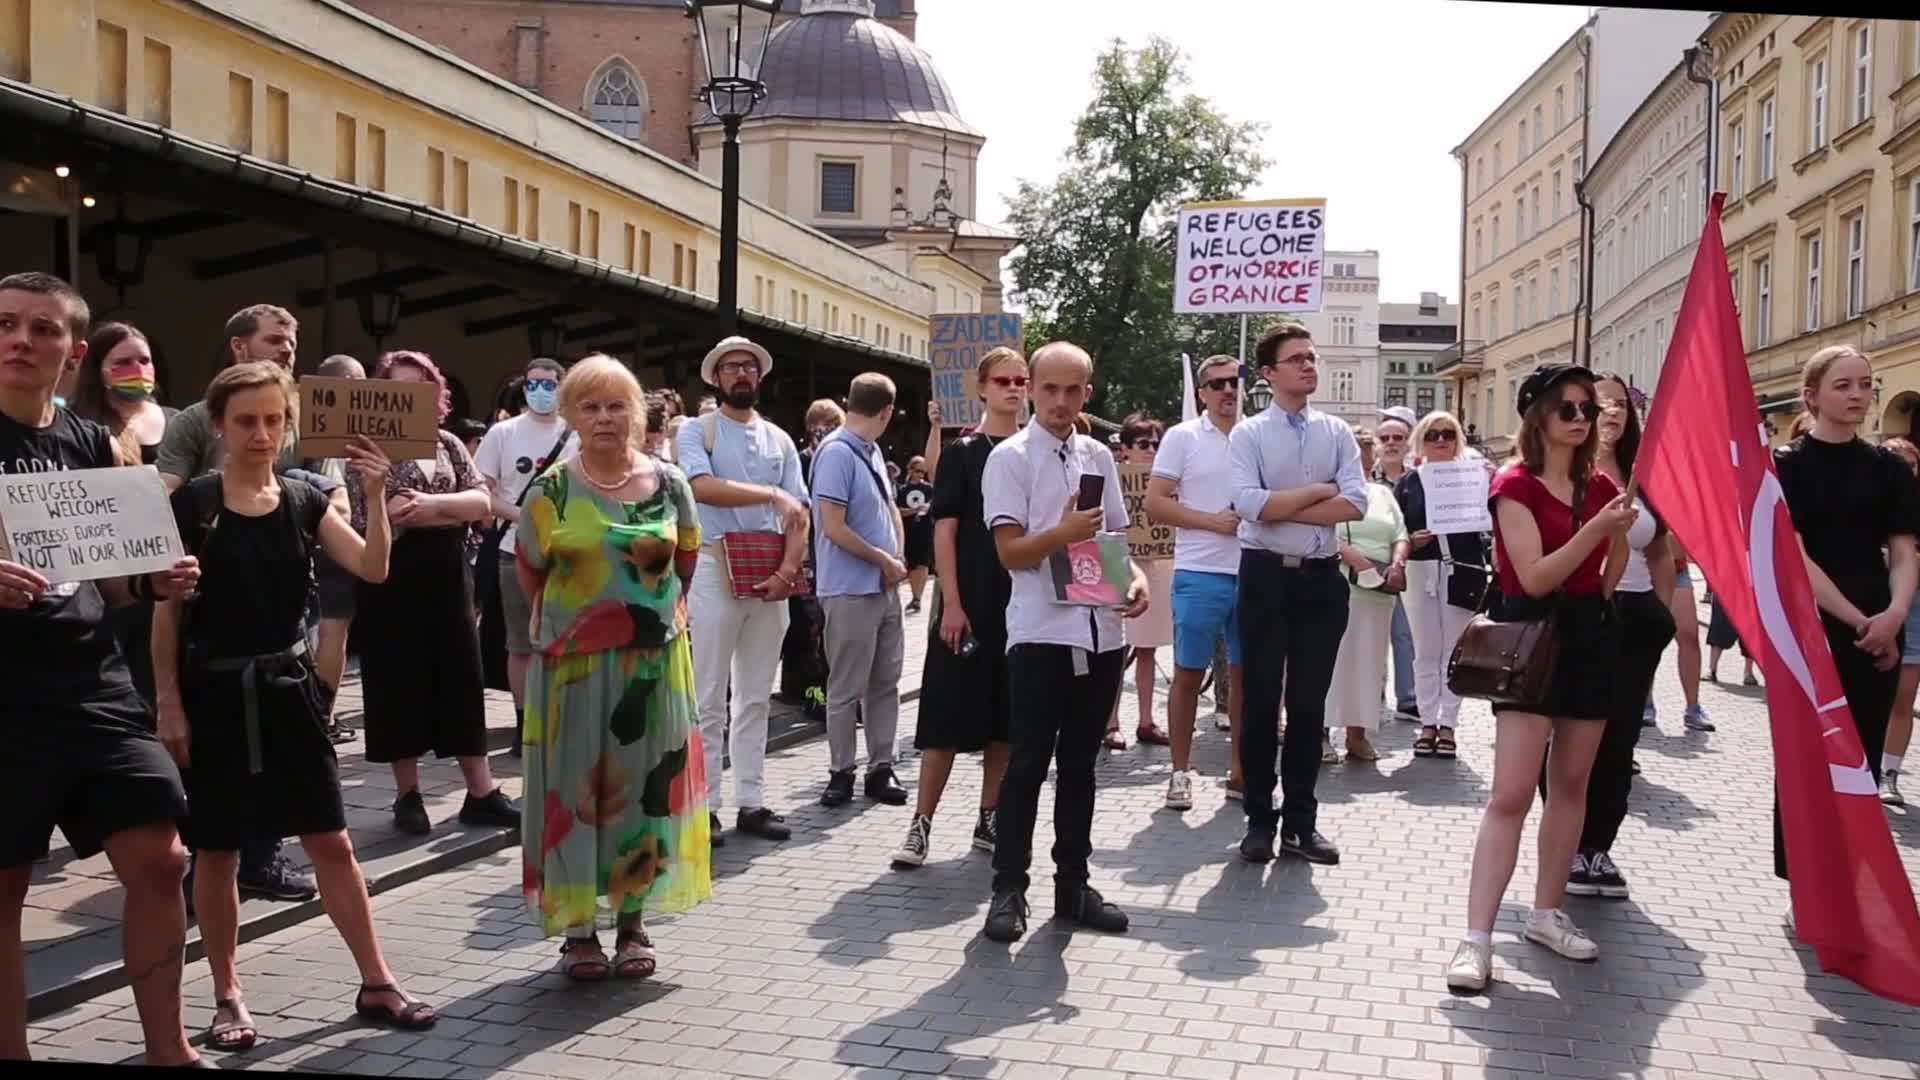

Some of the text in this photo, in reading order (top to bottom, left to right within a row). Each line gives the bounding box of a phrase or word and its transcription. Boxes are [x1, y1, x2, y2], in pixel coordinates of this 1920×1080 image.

[1187, 208, 1322, 234] REFUGEES
[1190, 233, 1316, 259] WELCOME
[1188, 282, 1312, 306] GRANICE
[312, 389, 413, 413] NO HUMAN
[311, 413, 408, 438] IS ILLEGAL
[7, 480, 88, 504] REFUGEES
[47, 497, 119, 520] WELCOME
[12, 523, 117, 547] FORTRESS EUROPE
[1151, 527, 1170, 540] OD
[19, 545, 61, 570] NOT
[69, 546, 85, 566] IN
[89, 543, 118, 562] OUR
